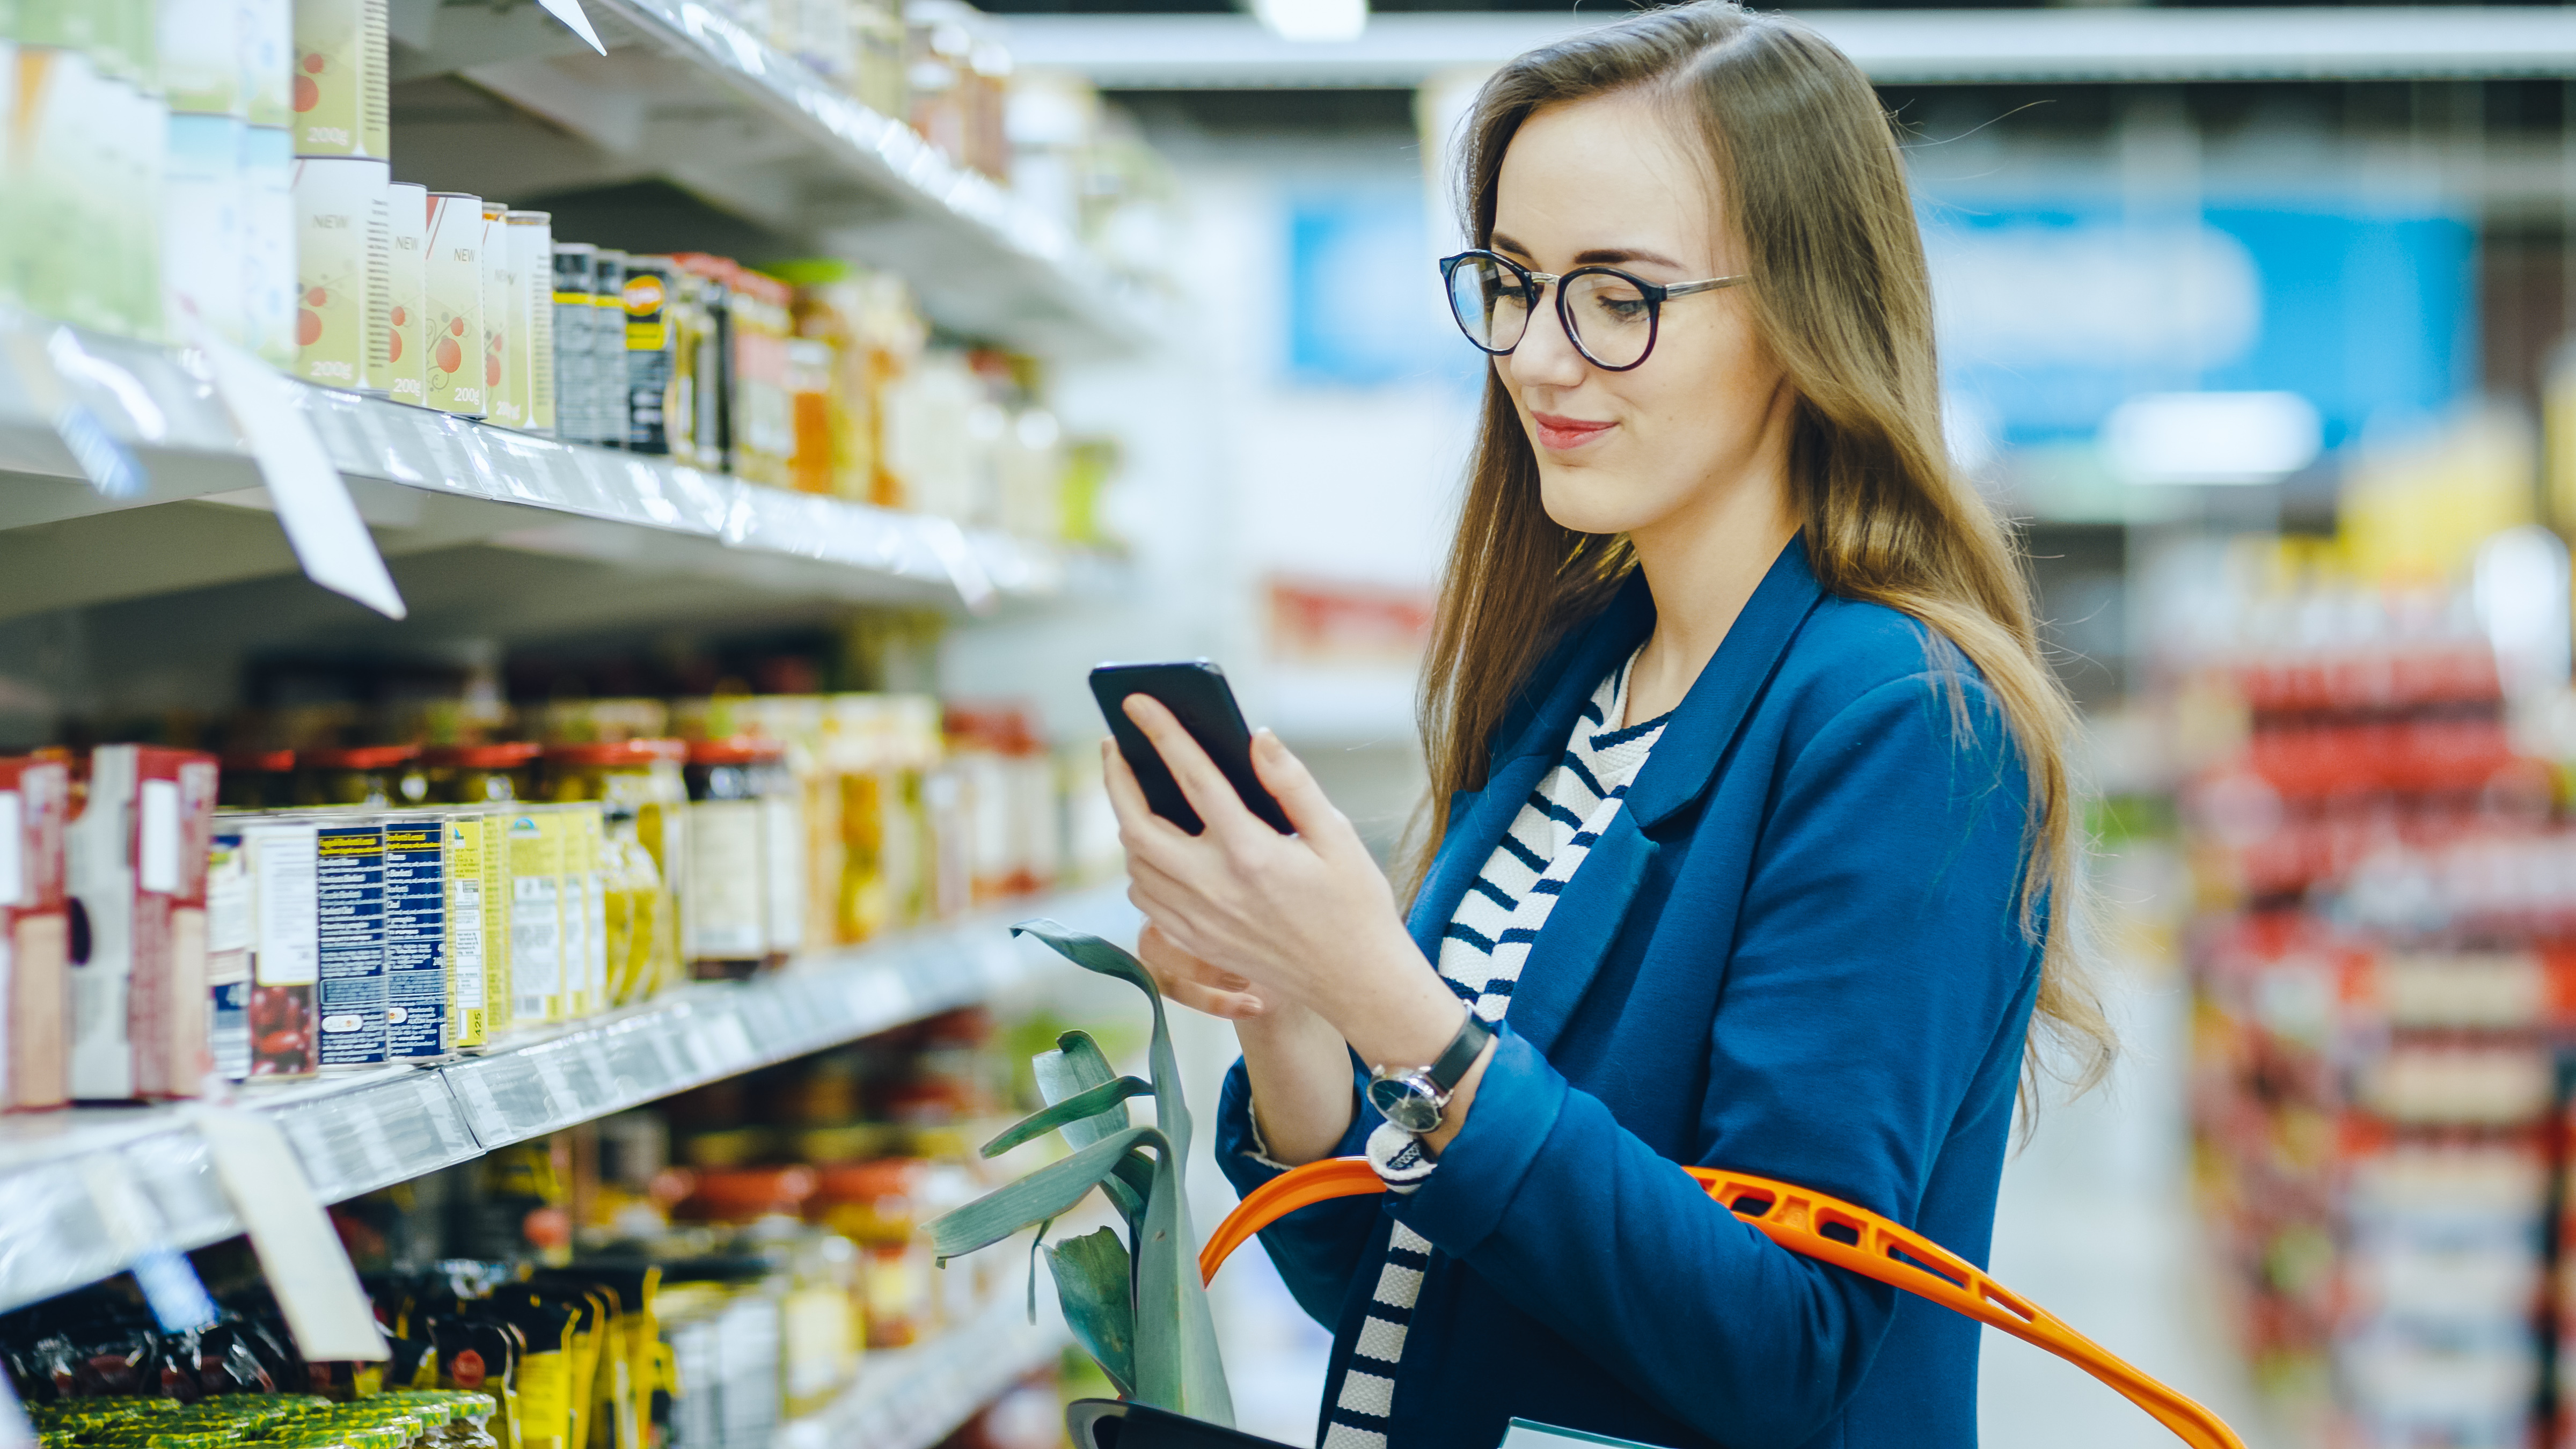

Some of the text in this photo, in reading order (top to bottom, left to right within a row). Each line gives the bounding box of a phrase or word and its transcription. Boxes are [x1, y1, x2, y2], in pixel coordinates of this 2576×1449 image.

[307, 127, 348, 147] 200g
[312, 215, 349, 229] NEW
[396, 236, 418, 250] NEW
[454, 248, 475, 262] NEW
[311, 361, 353, 380] 200g
[393, 378, 421, 397] 200g
[454, 387, 480, 405] 200g
